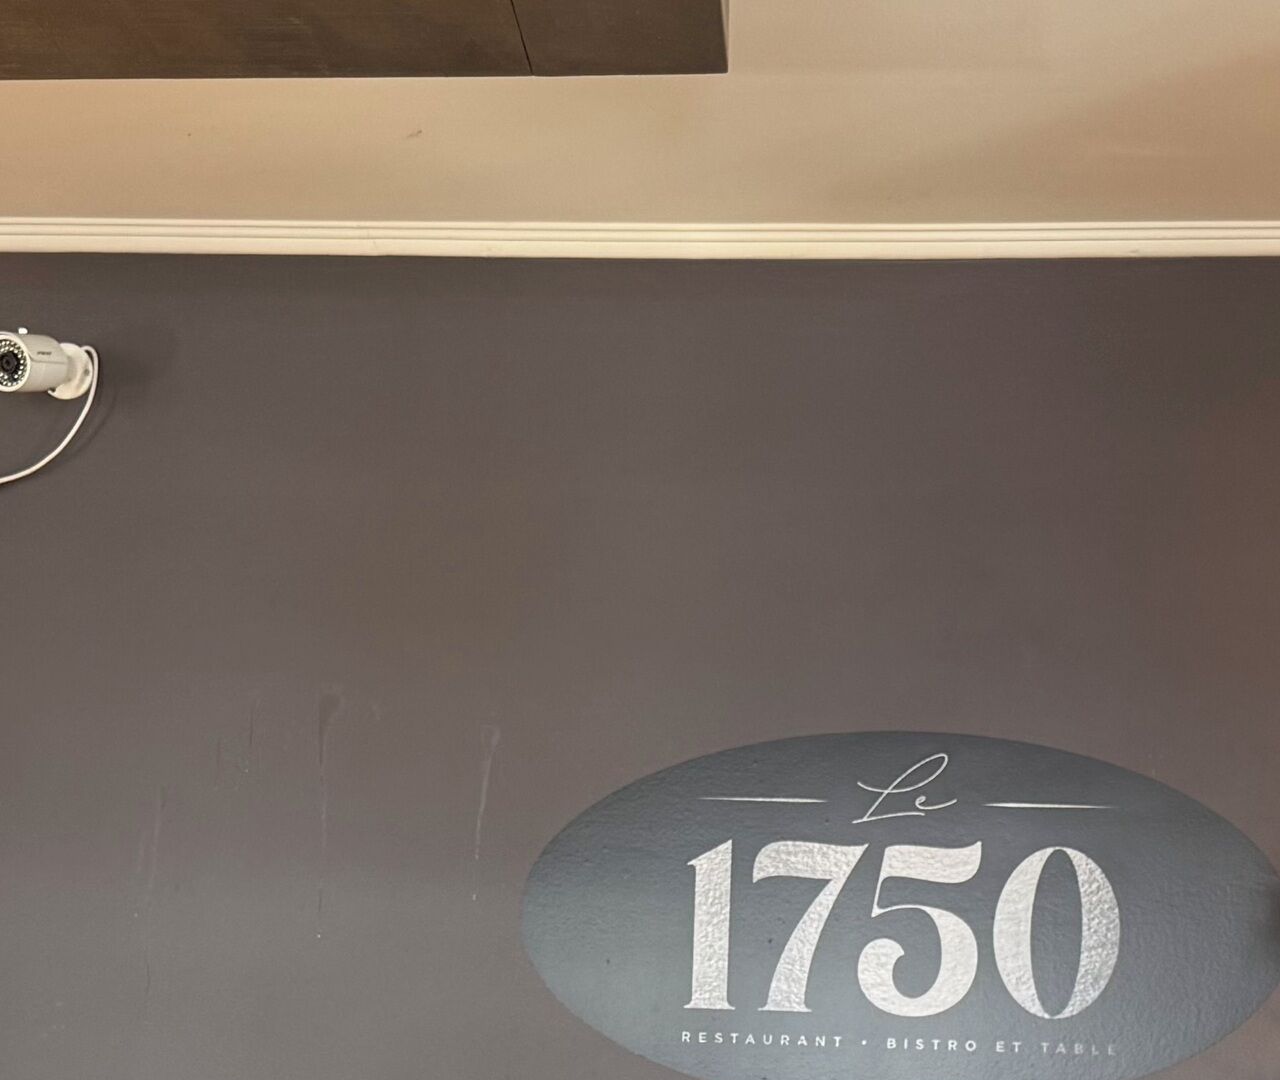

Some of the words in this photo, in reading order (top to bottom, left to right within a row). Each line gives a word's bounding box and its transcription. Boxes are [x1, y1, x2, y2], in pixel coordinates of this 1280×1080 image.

[852, 753, 958, 823] Le
[683, 839, 1120, 1019] 1750
[681, 1031, 842, 1047] RESTAURANT
[886, 1038, 977, 1052] BISTRO
[995, 1041, 1022, 1053] ET
[1041, 1042, 1117, 1056] TABLE
